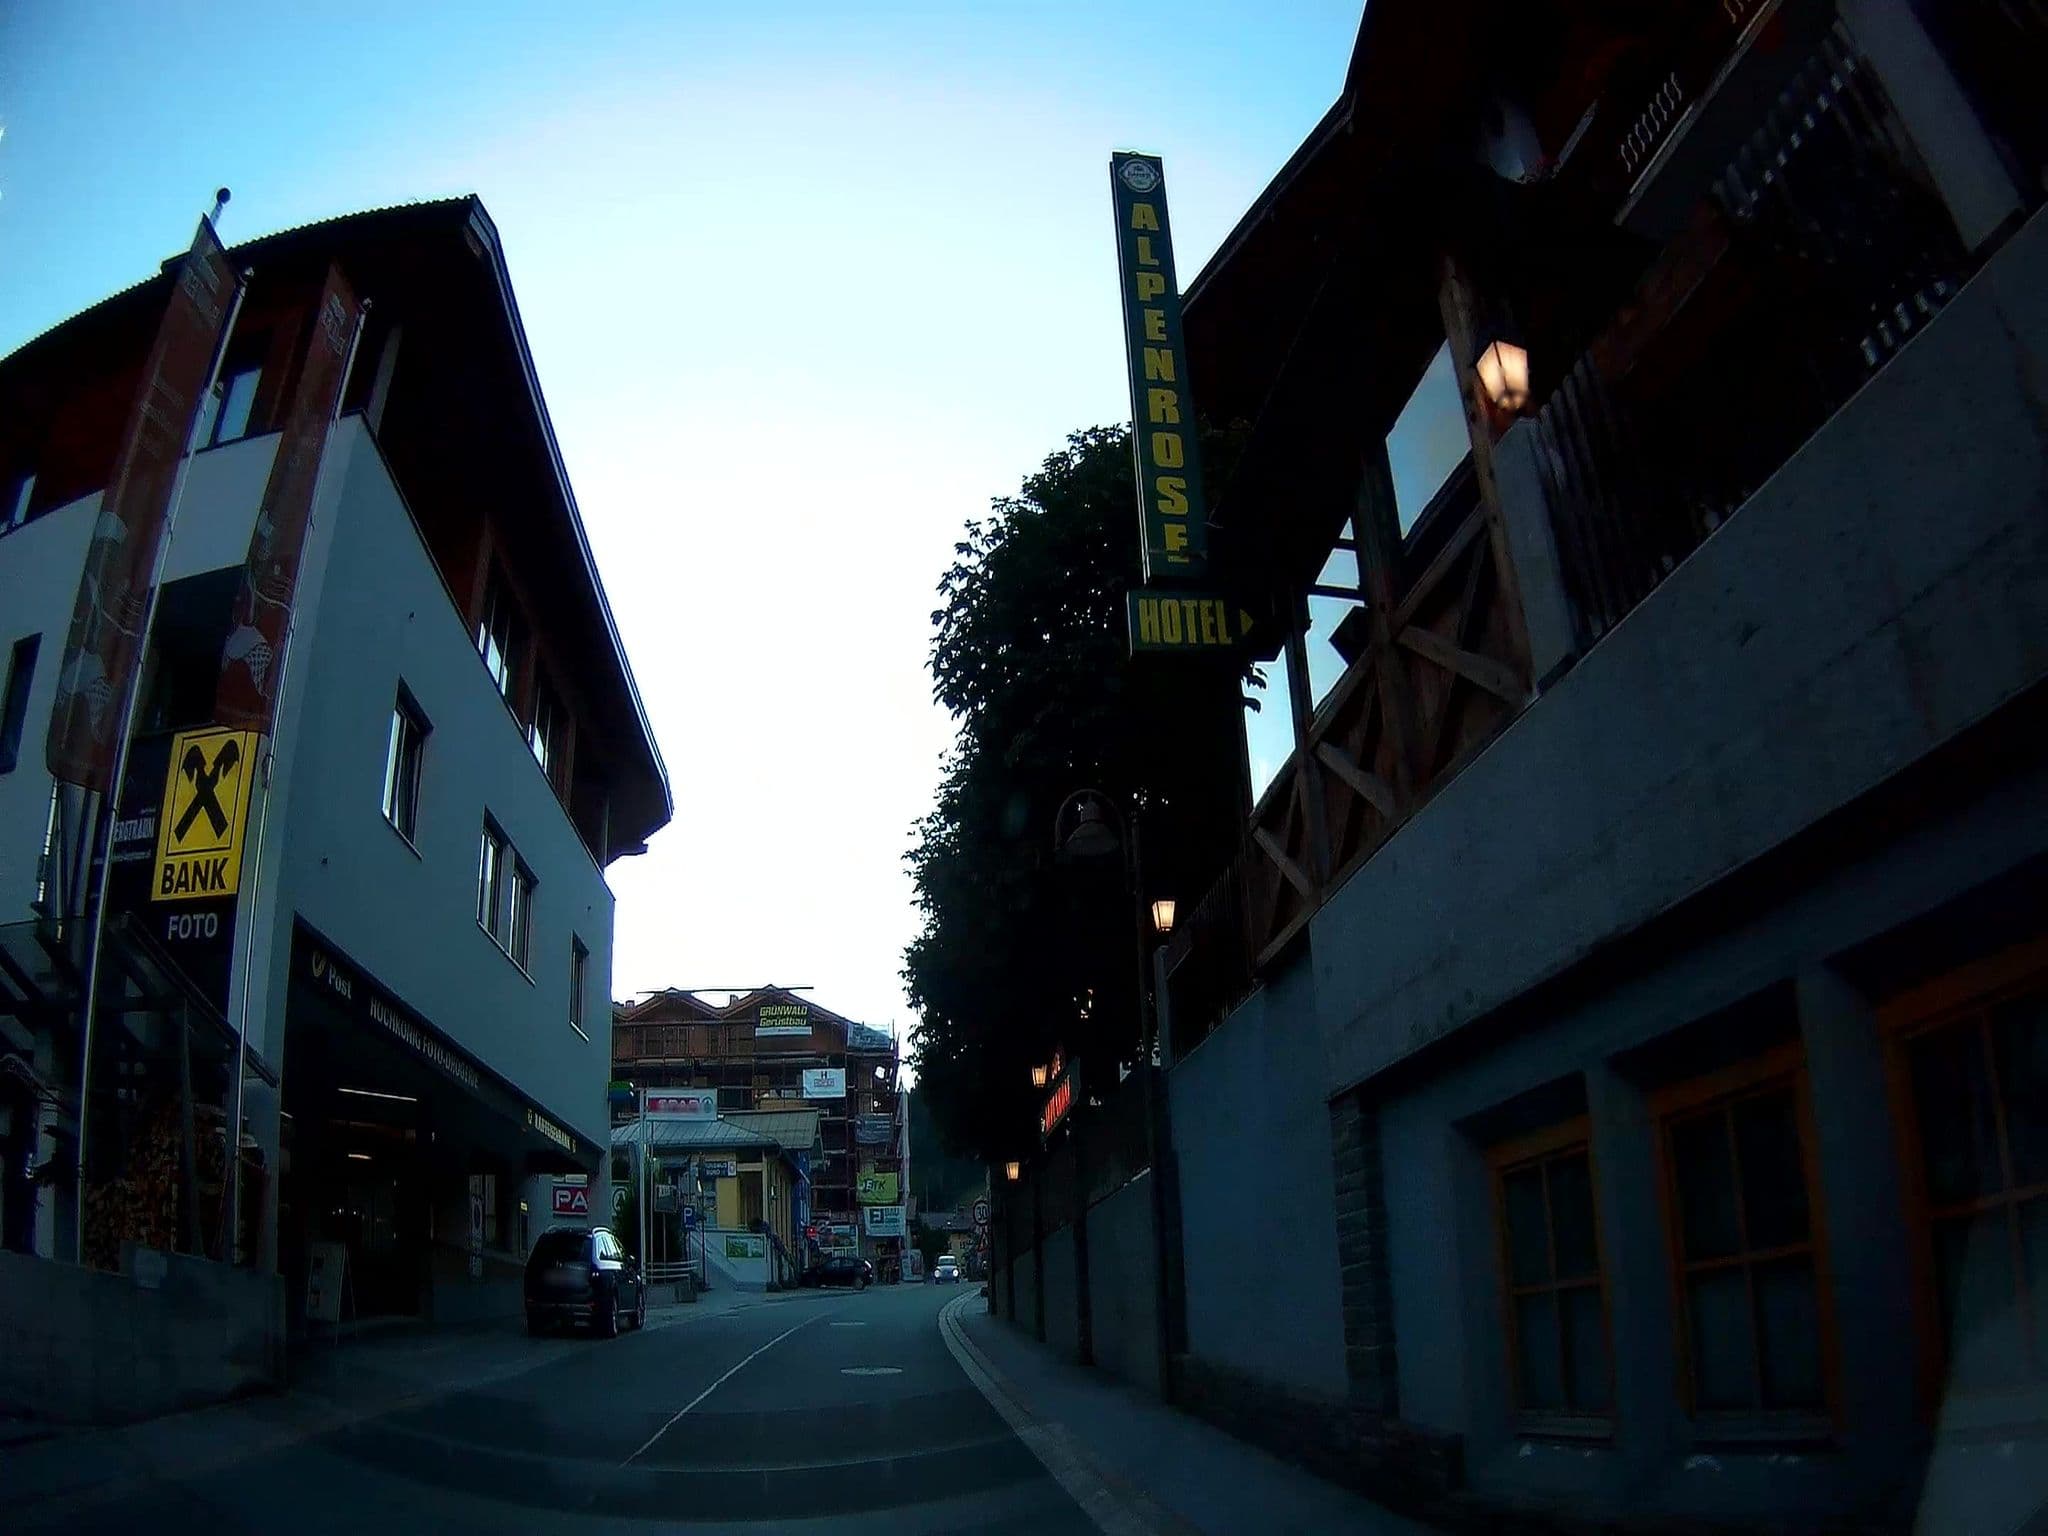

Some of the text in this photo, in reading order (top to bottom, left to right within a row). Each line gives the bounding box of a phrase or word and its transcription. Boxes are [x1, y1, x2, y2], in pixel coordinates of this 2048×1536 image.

[1130, 202, 1190, 565] ALPENROSE
[1138, 598, 1233, 646] HOTEL
[161, 857, 229, 895] BANK
[168, 912, 219, 942] FOTO
[328, 963, 352, 1000] Post
[683, 1206, 693, 1224] P
[976, 1205, 989, 1221] 30
